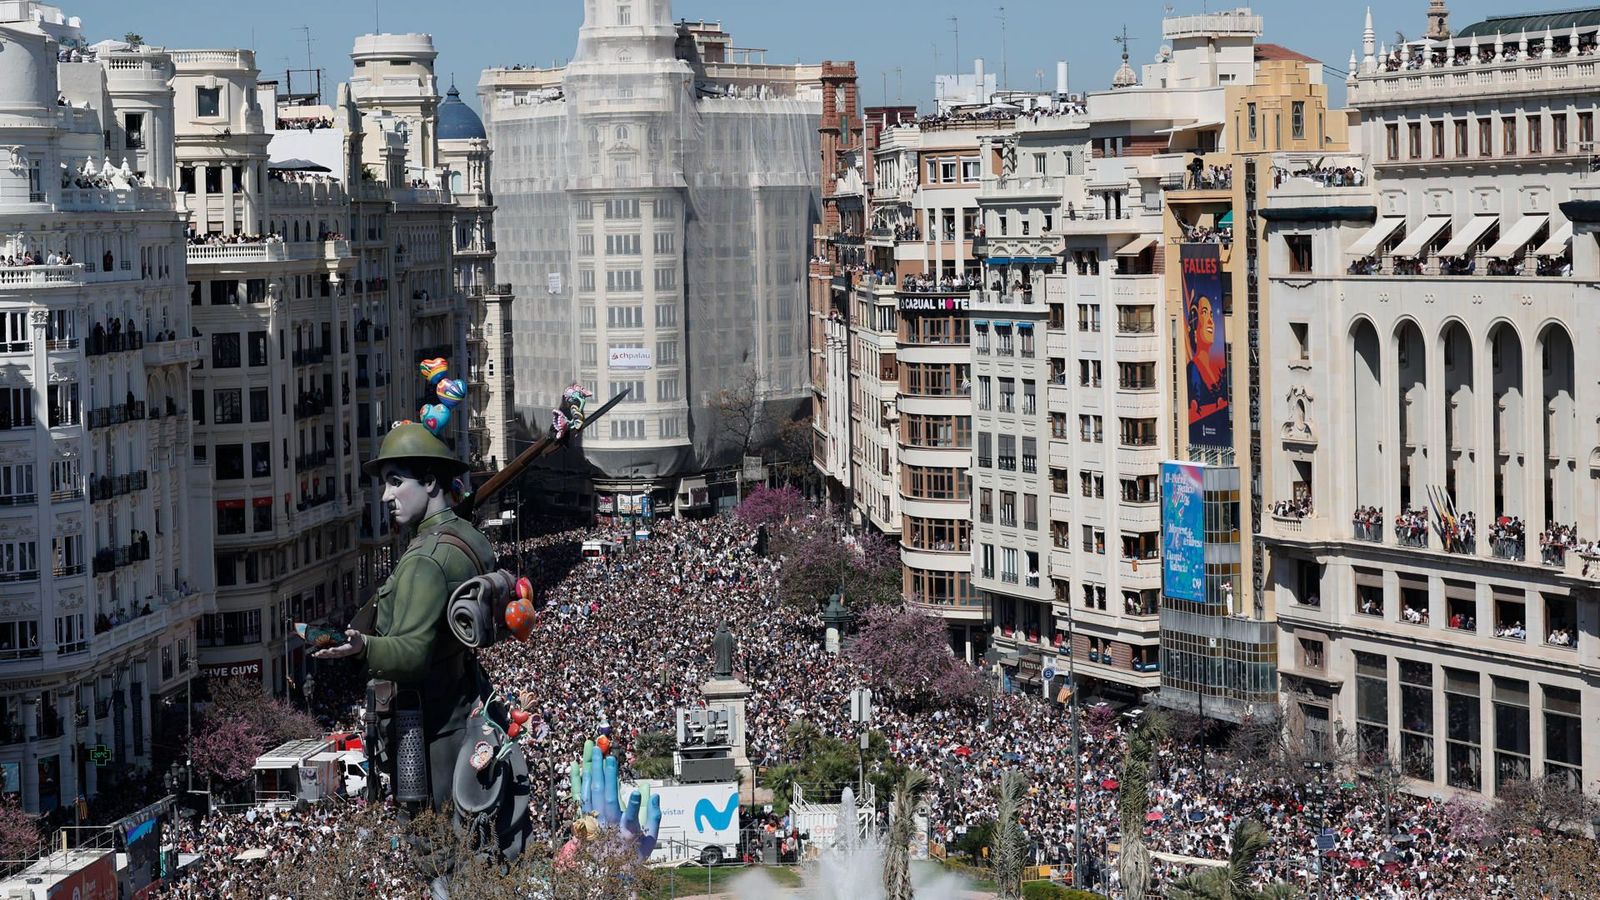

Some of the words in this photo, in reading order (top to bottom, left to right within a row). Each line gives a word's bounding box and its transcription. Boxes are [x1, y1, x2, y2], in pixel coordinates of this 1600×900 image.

[1184, 258, 1217, 274] FALLES
[905, 298, 936, 310] CASUAL
[938, 297, 969, 310] HOTE
[201, 667, 228, 677] FIVE
[231, 664, 258, 675] GUYS
[661, 807, 685, 816] vistar
